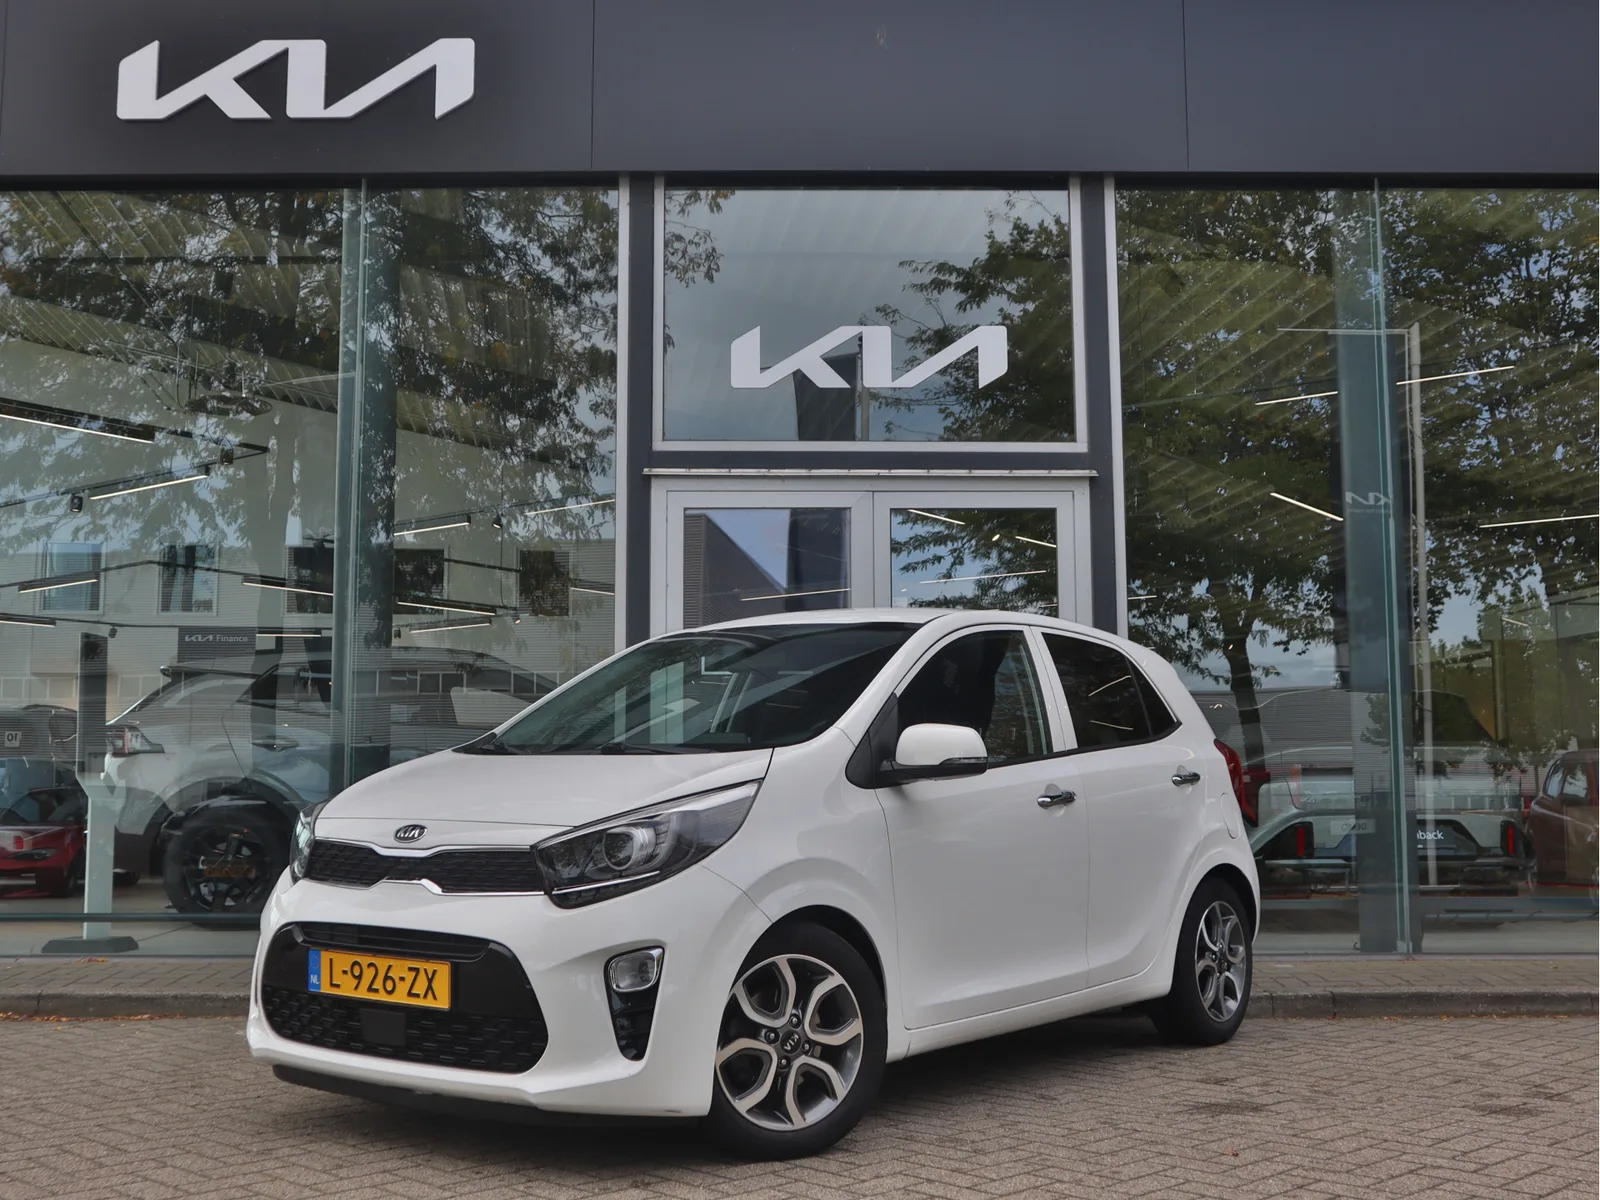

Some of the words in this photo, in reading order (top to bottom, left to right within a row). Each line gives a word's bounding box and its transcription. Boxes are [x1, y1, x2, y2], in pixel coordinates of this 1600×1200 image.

[117, 37, 475, 120] KIA
[730, 325, 1008, 389] KIA
[185, 634, 214, 642] KIA
[216, 634, 249, 643] Finance
[397, 827, 421, 839] KIA
[310, 973, 320, 985] NL
[328, 954, 438, 1001] L-926-ZX
